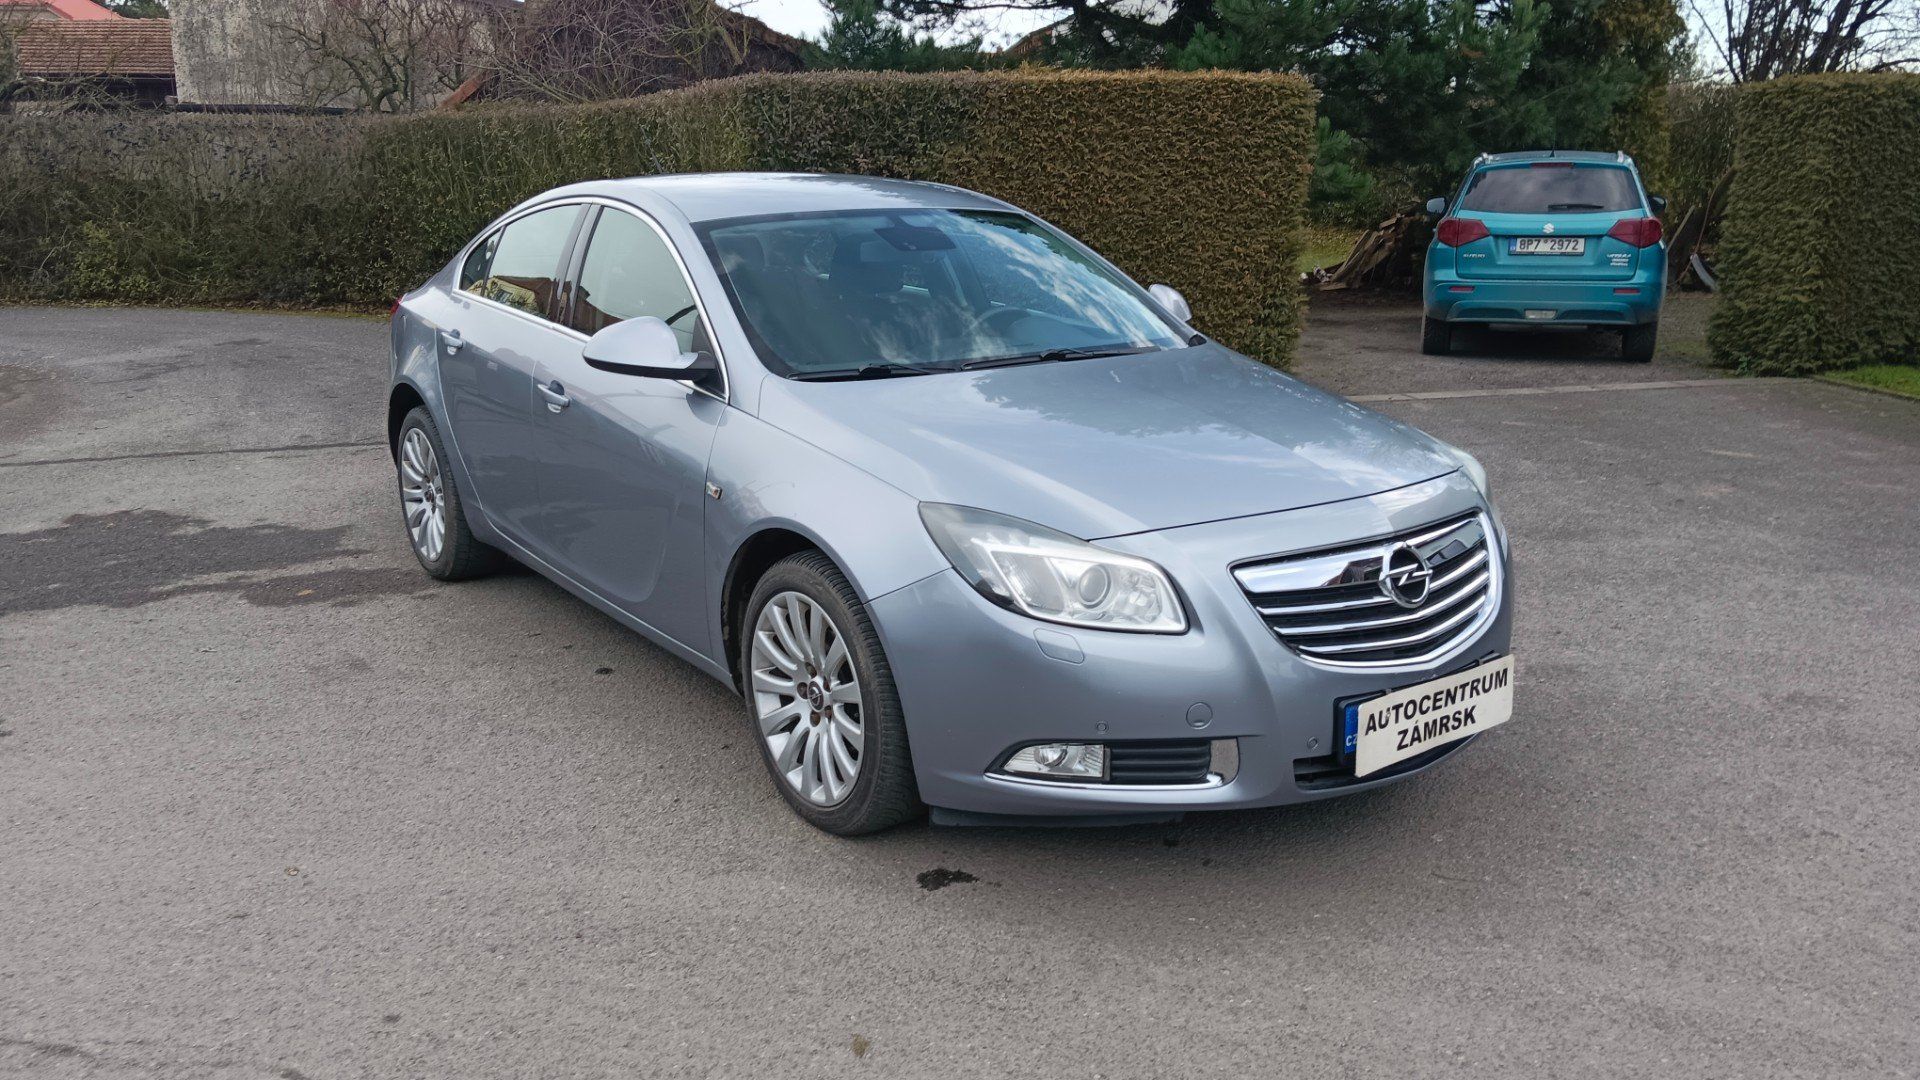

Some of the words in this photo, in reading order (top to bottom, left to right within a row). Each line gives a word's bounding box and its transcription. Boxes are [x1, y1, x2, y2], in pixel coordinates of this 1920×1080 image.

[1519, 239, 1541, 251] 8P7
[1550, 239, 1579, 251] 2972
[1365, 668, 1509, 736] AUTOCENTRUM
[1397, 705, 1477, 751] ZÁMRSK
